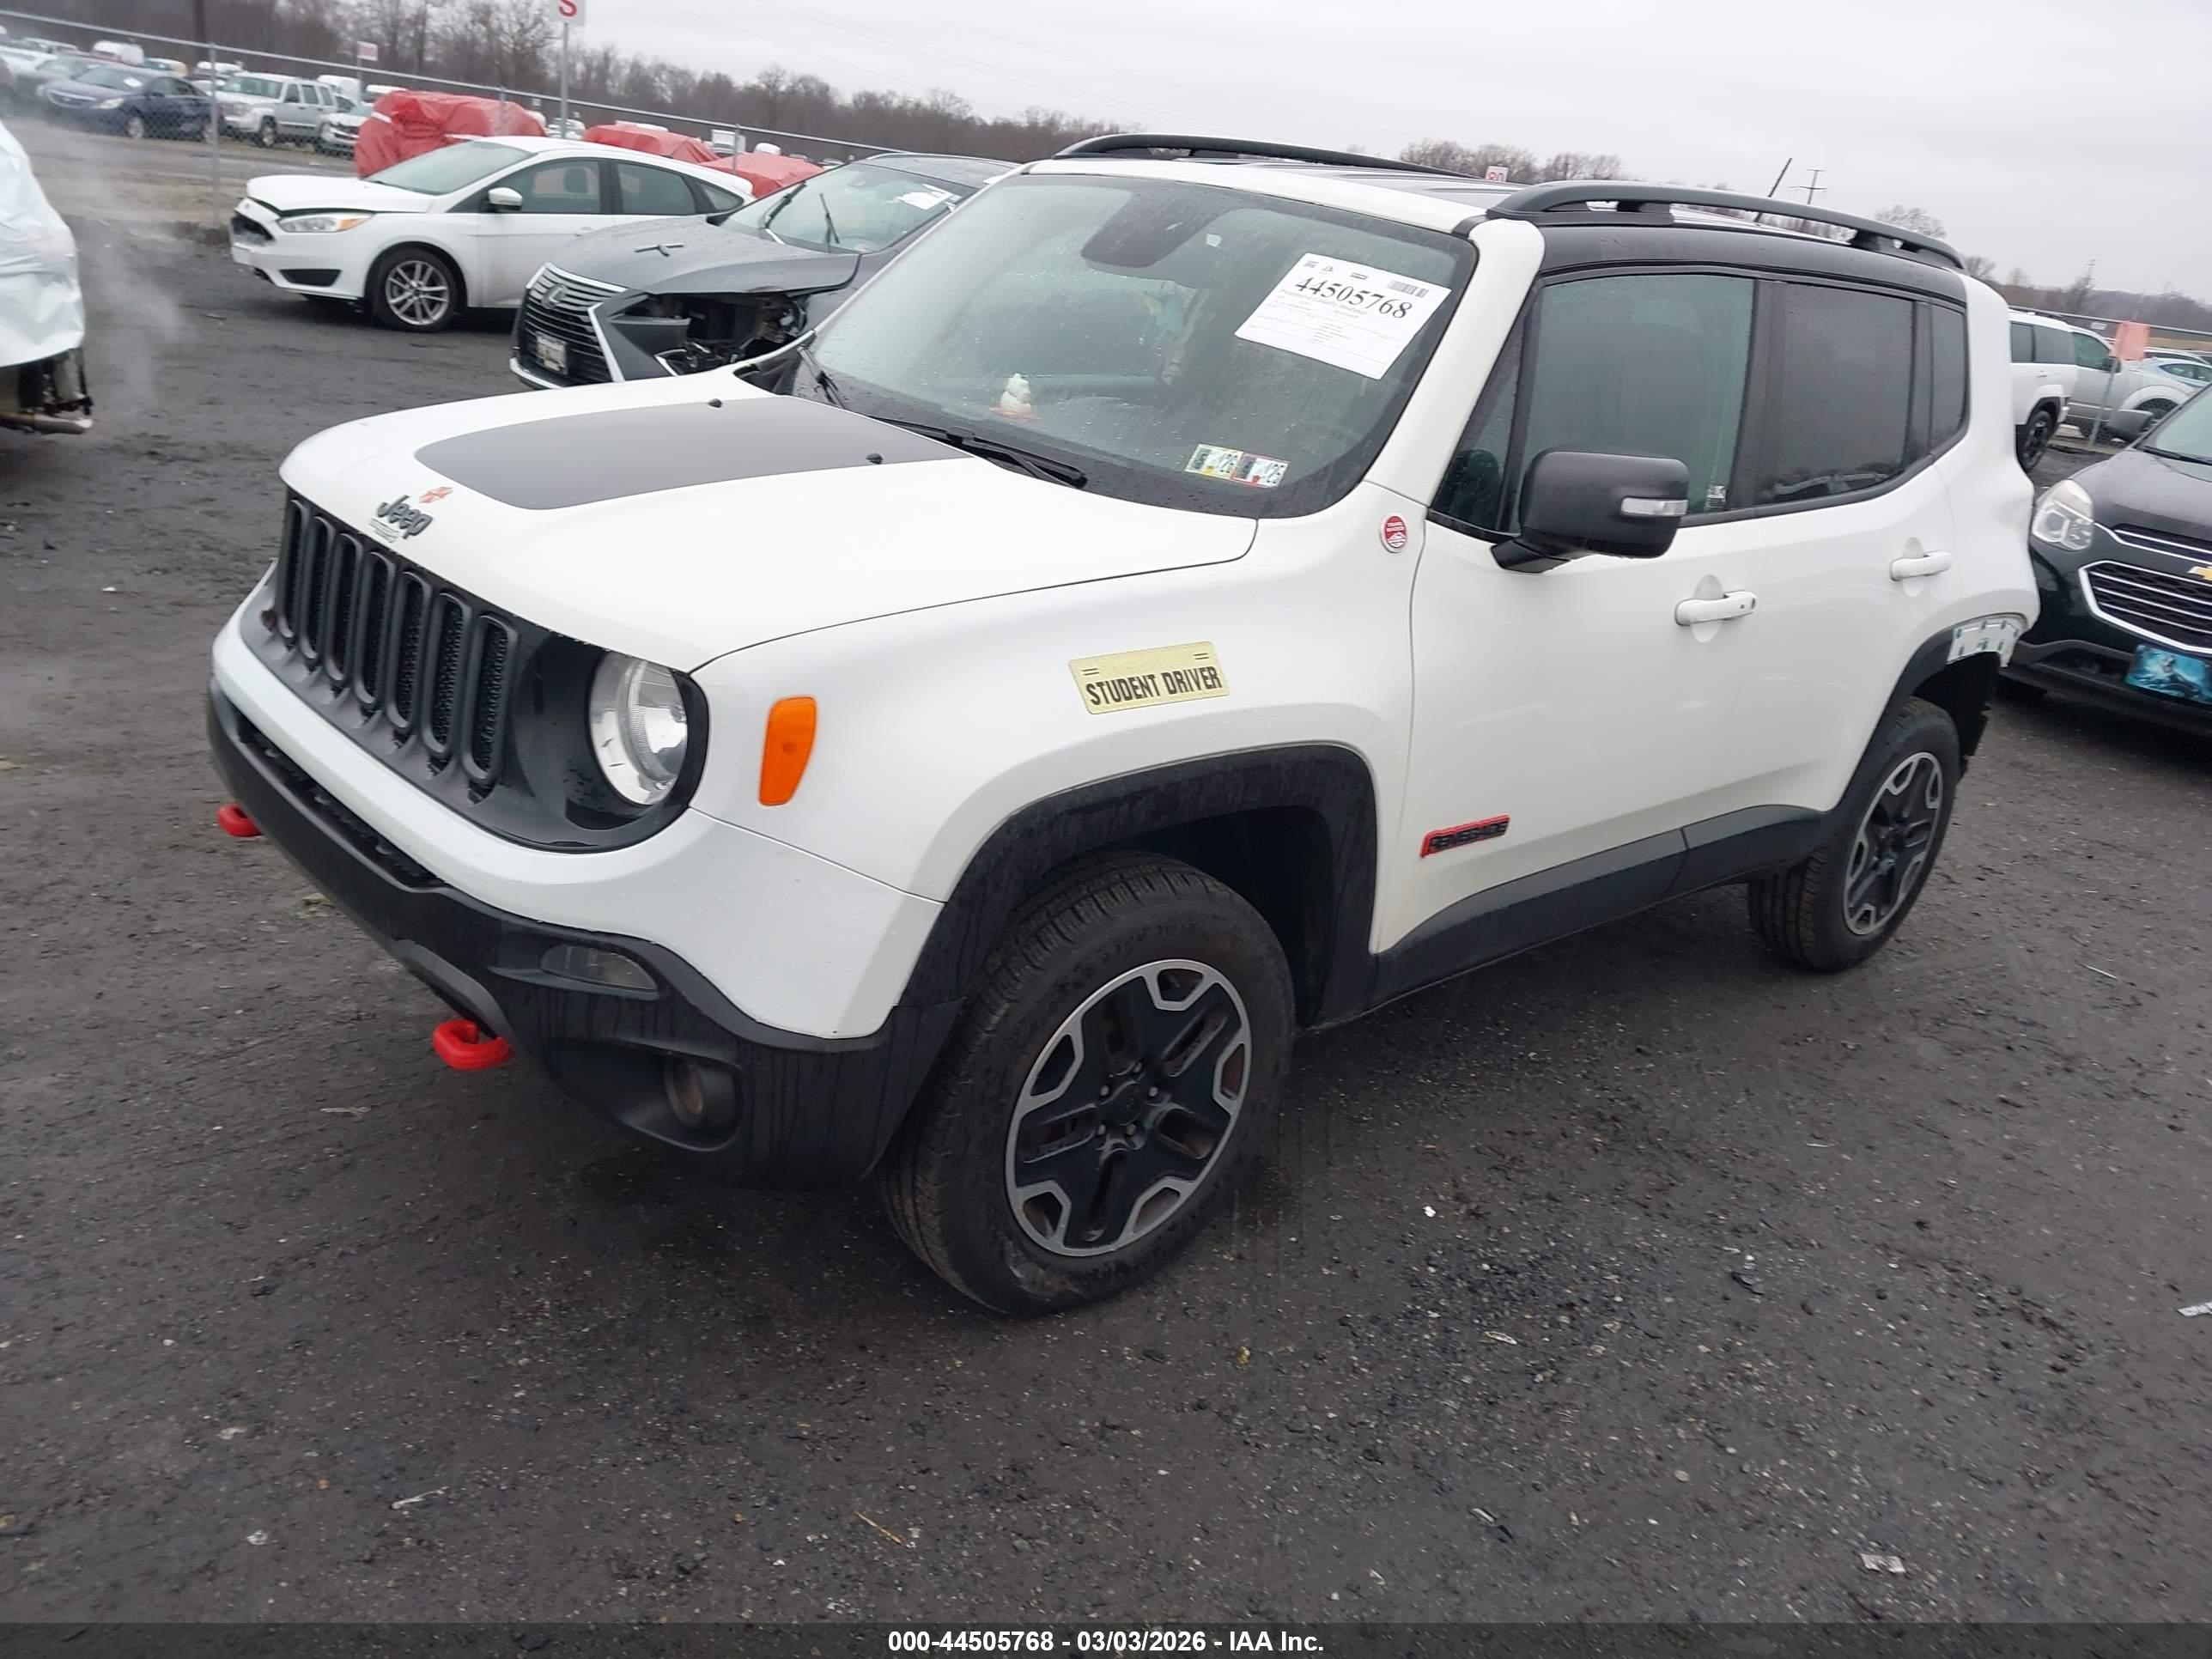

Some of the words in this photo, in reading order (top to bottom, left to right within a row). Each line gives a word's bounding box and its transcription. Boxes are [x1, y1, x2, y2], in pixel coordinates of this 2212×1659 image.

[1295, 276, 1413, 319] 44505768
[376, 495, 433, 539] Jeep
[1085, 674, 1161, 705] STUDENT
[1161, 665, 1223, 695] DRIVER
